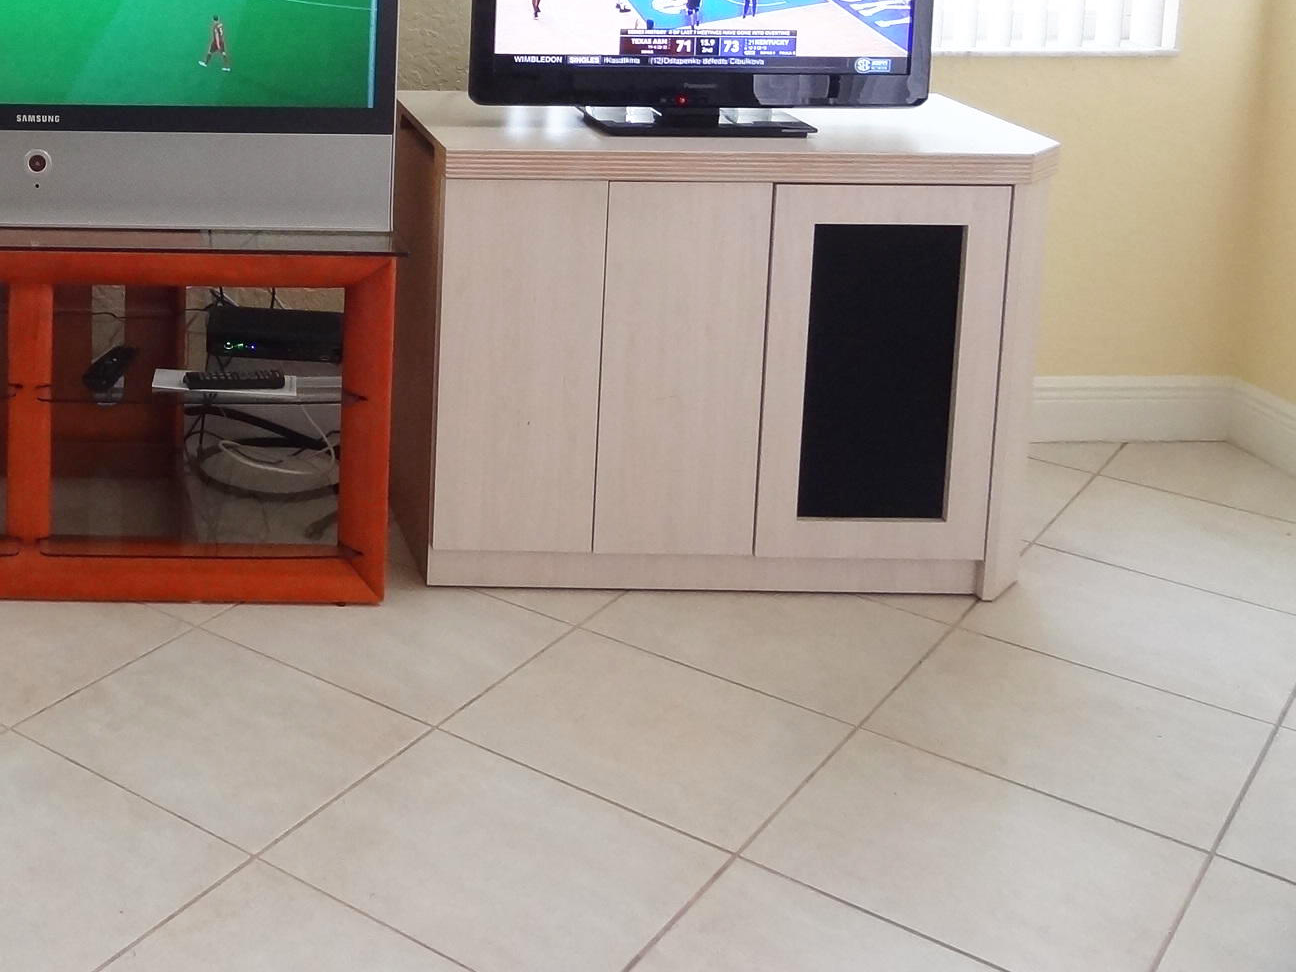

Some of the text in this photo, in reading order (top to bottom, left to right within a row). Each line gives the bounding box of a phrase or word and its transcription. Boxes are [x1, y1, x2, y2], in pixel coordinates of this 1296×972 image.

[676, 39, 691, 53] 71
[723, 40, 739, 53] 73
[514, 56, 563, 64] WIMBLEDON
[569, 56, 600, 64] SINGLES
[16, 114, 60, 123] SAMSUNG
